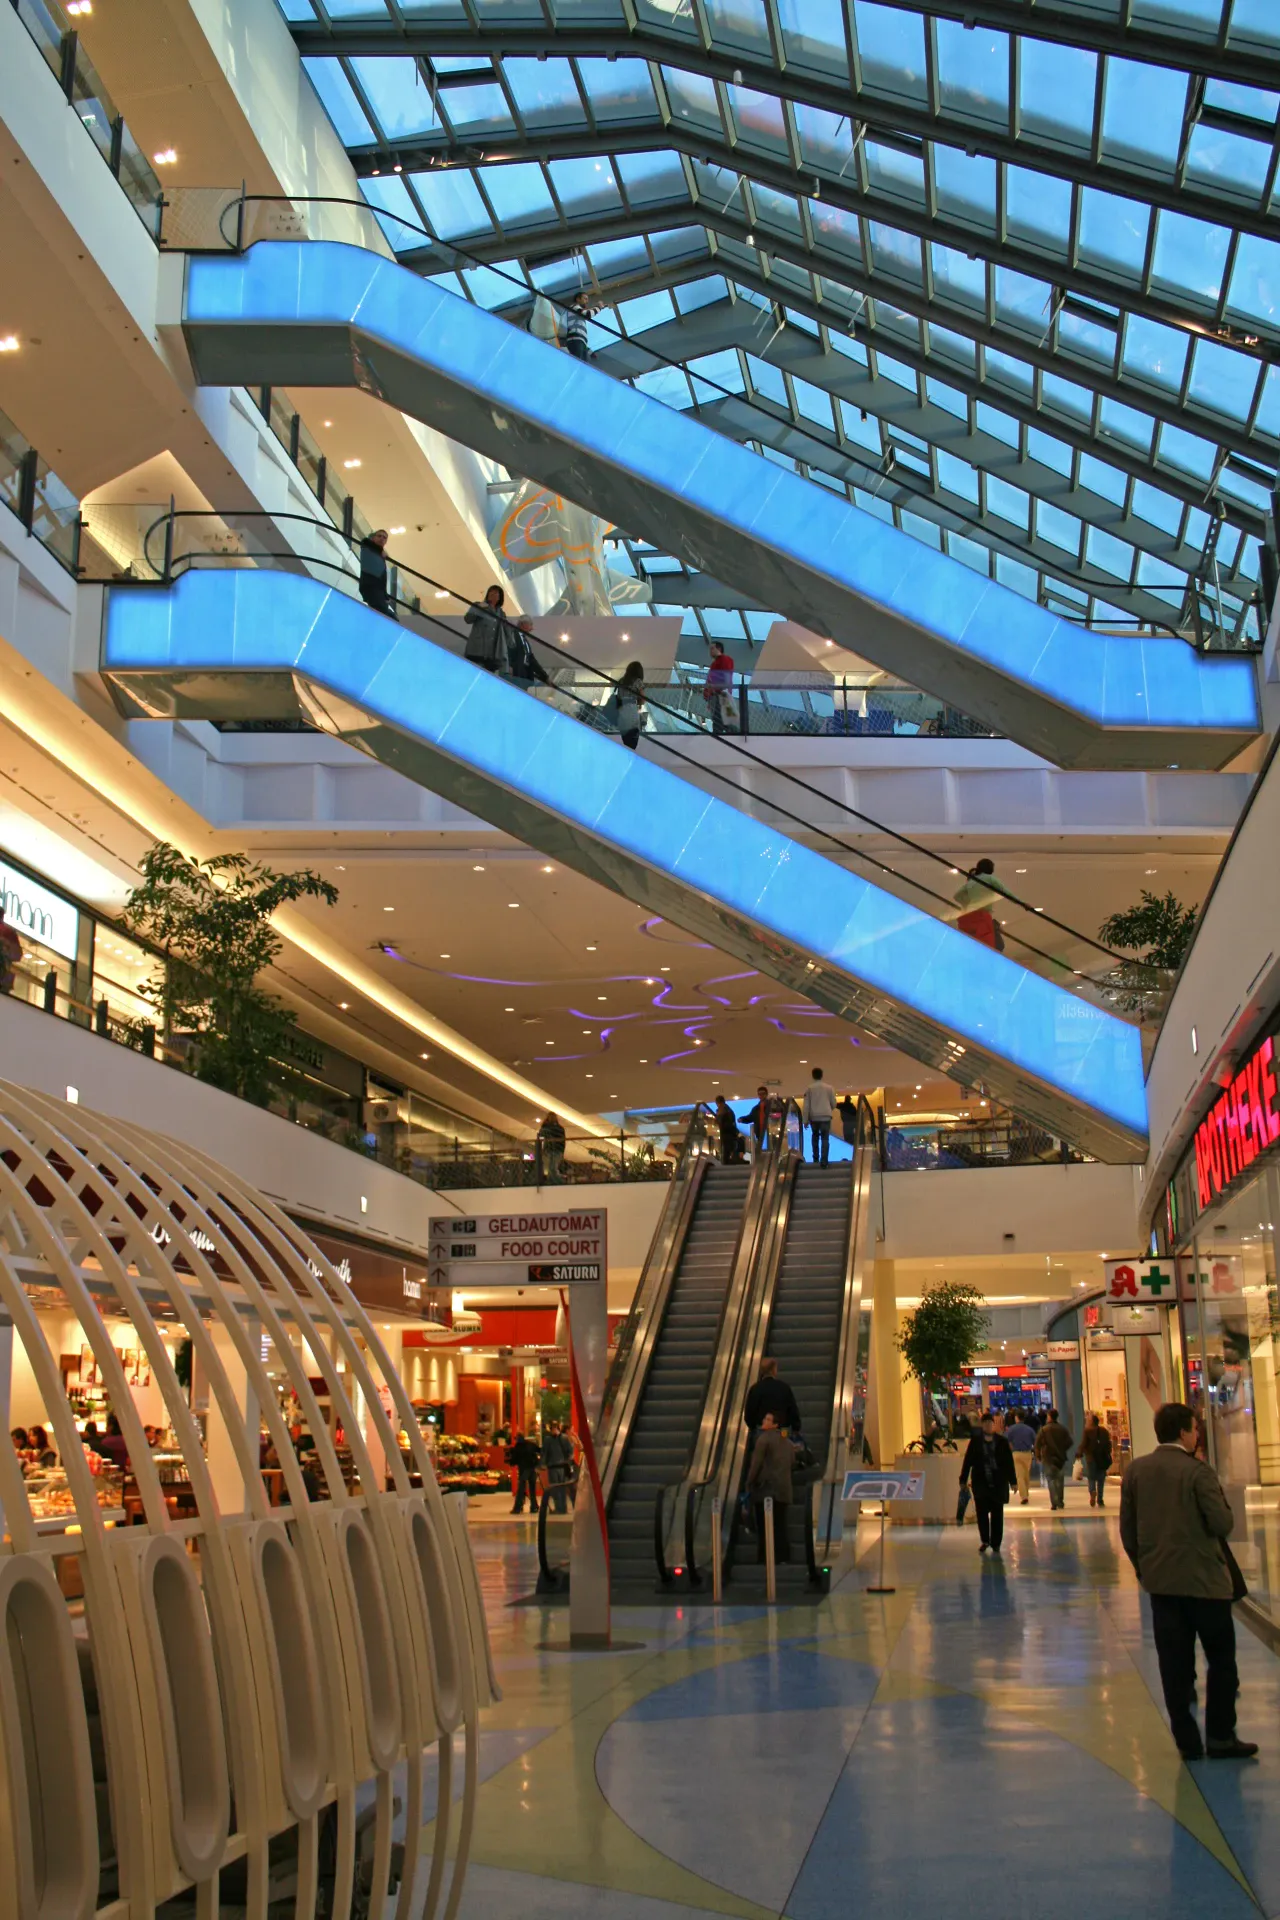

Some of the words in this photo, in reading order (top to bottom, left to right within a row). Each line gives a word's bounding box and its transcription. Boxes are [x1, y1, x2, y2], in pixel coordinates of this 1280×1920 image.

[1194, 1036, 1280, 1210] APOTHEKE
[489, 1215, 600, 1233] GELDAUTOMAT
[501, 1241, 542, 1256] FOOD
[548, 1240, 600, 1255] COURT
[552, 1265, 598, 1280] SATURN
